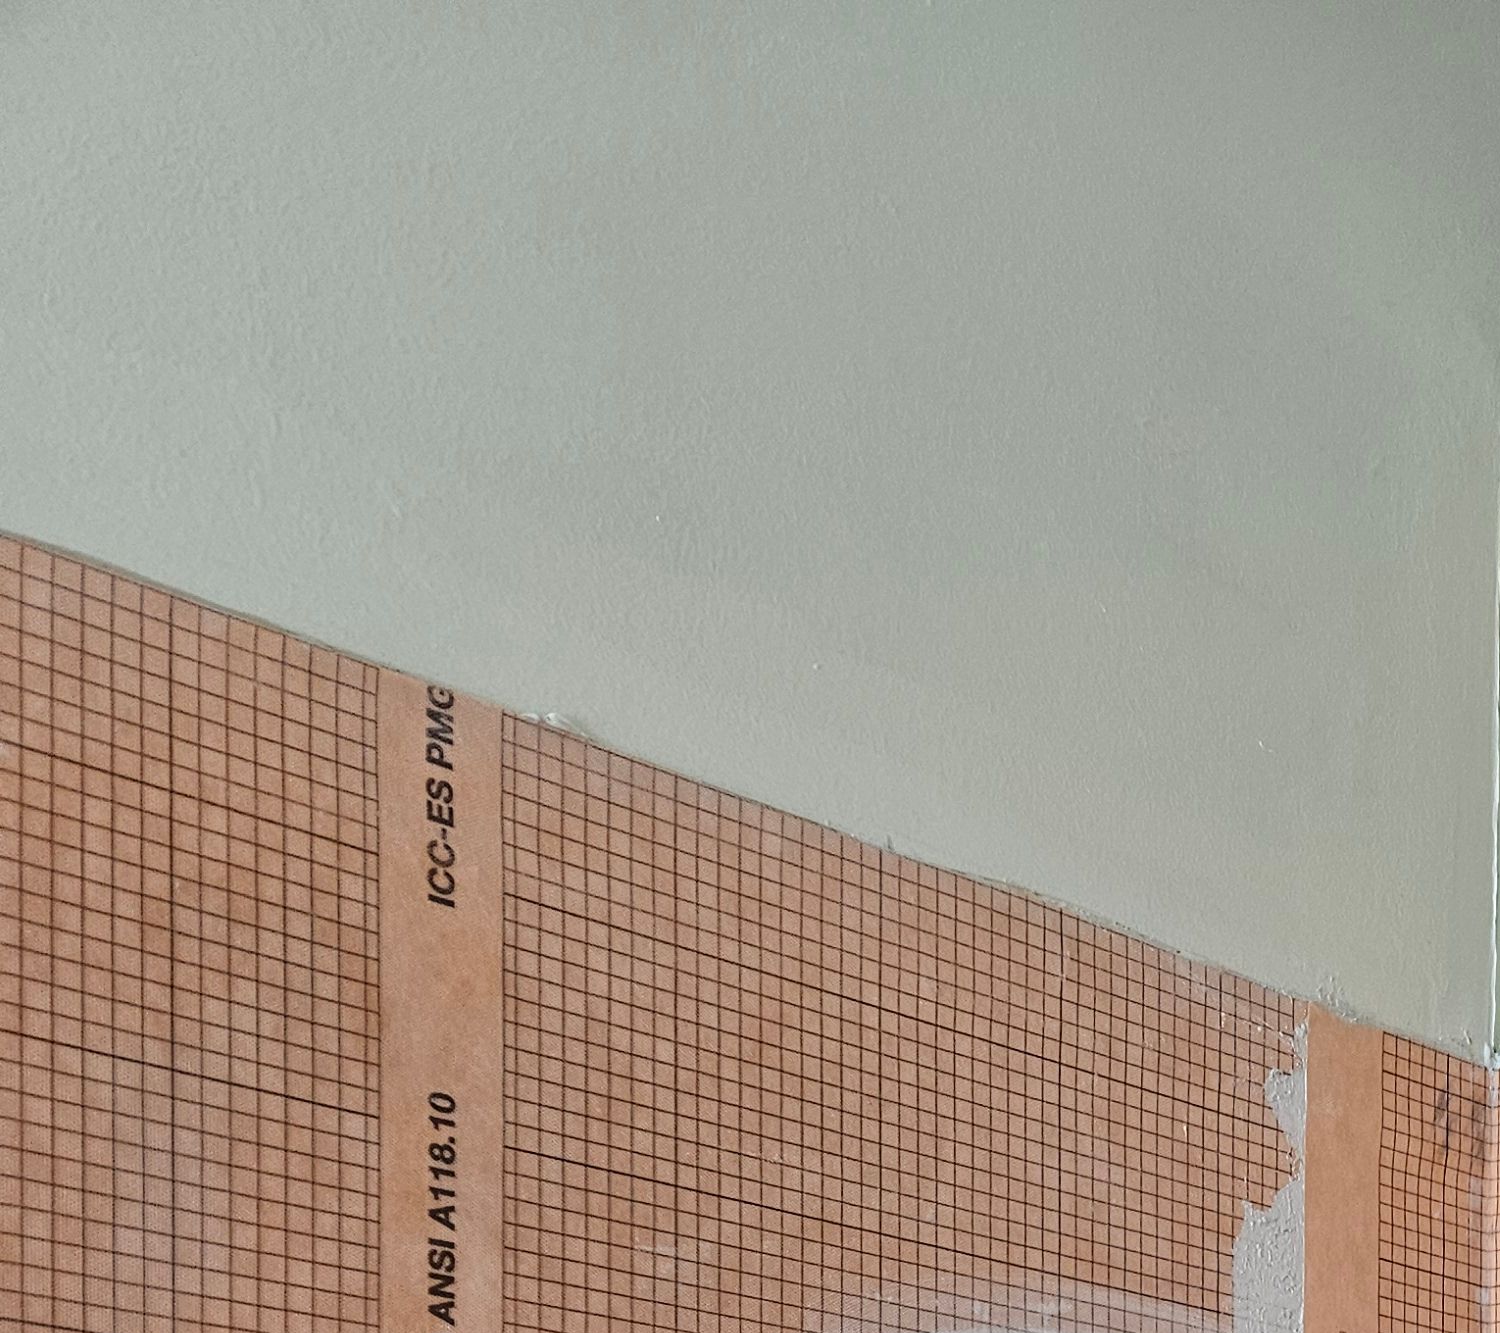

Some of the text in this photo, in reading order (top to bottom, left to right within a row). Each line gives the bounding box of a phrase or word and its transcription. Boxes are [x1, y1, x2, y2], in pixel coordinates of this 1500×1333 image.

[426, 777, 455, 908] ICC-ES
[428, 1092, 455, 1231] A118.10
[428, 1238, 455, 1325] ANSI
